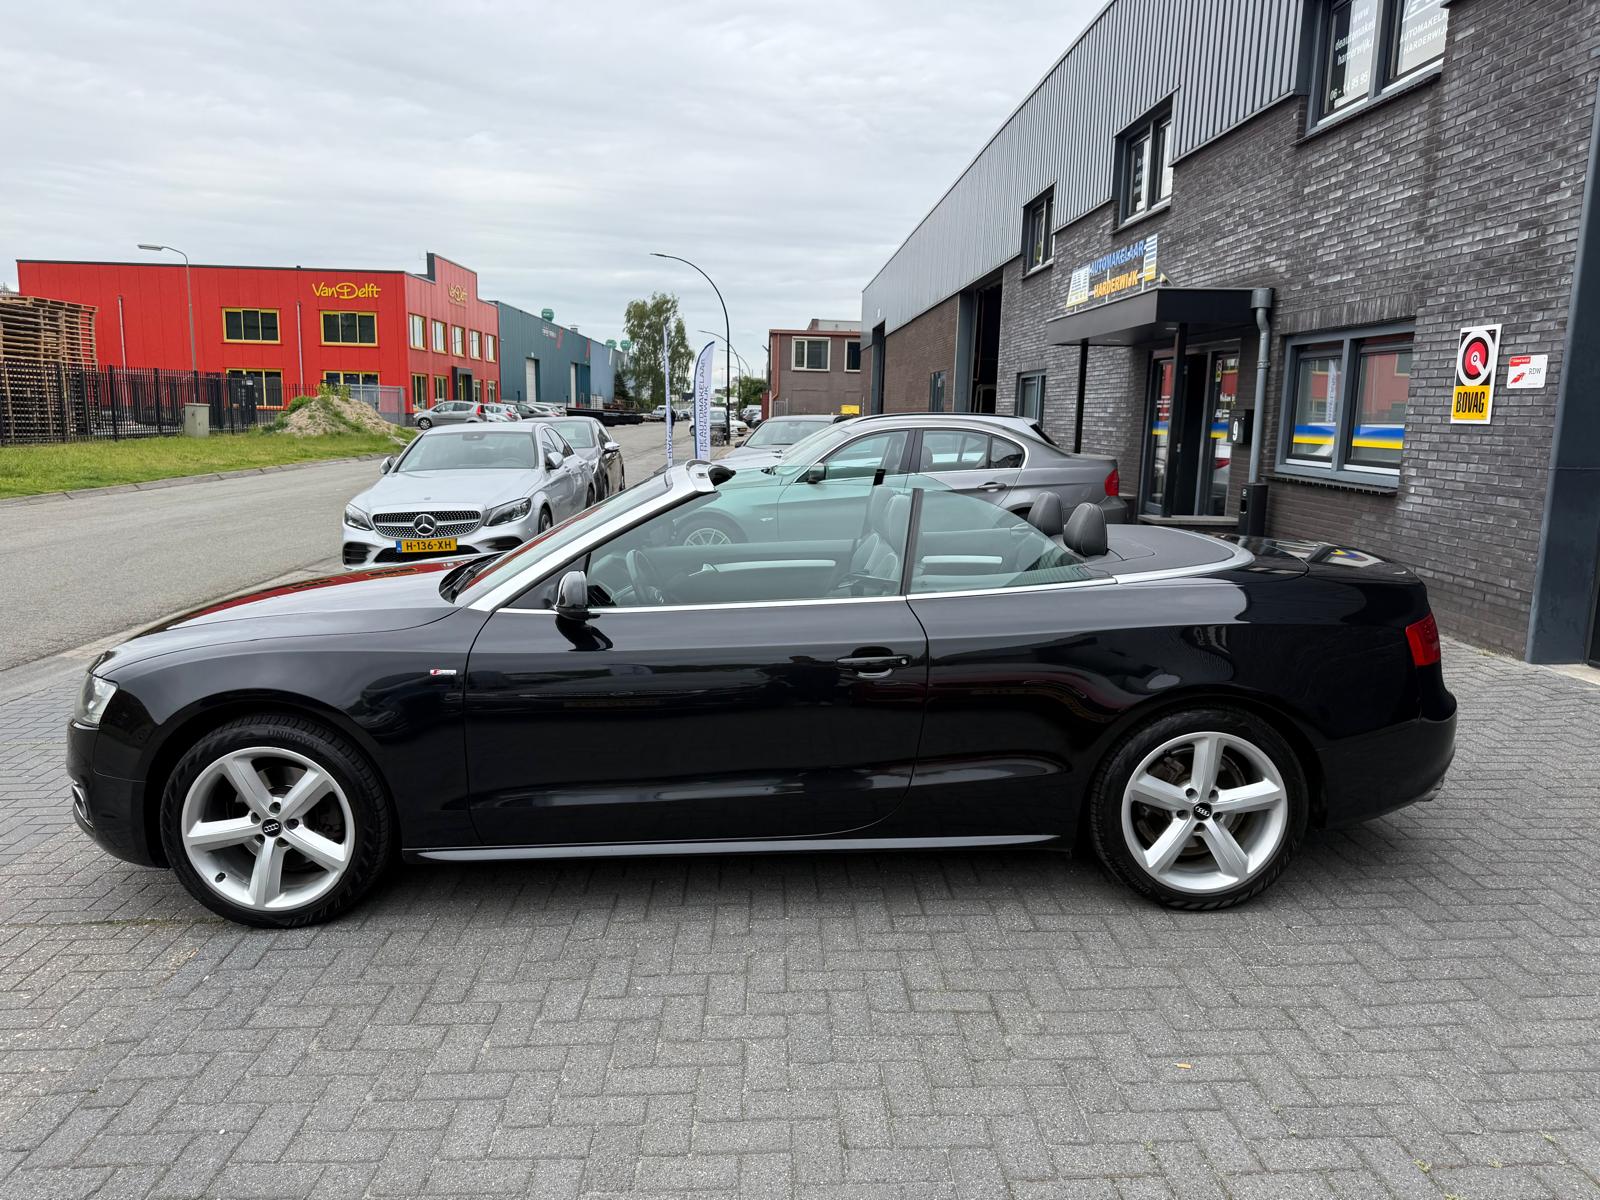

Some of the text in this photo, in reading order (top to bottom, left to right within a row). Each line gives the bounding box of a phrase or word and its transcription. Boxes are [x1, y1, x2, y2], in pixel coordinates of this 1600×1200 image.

[1089, 240, 1145, 276] AUTOMAKELAAR
[1093, 269, 1138, 299] HARDERWIJK
[1528, 367, 1542, 375] RDW
[1456, 391, 1485, 413] BOVAG
[1232, 420, 1239, 441] 9
[406, 540, 452, 551] H-136-XH
